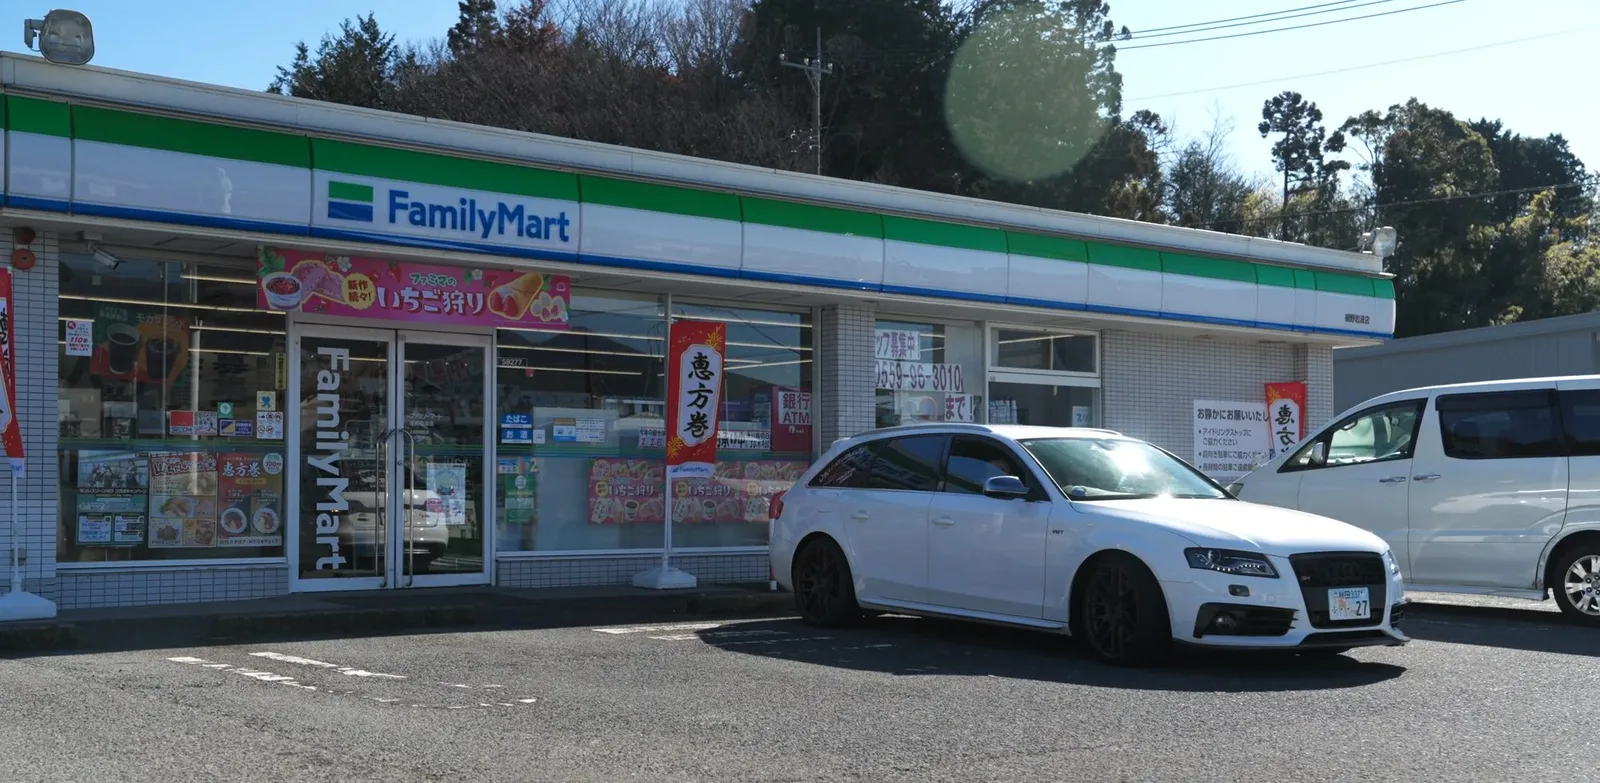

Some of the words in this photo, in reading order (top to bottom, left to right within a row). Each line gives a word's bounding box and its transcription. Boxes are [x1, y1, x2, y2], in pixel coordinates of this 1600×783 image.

[388, 189, 570, 242] FamilyMart
[348, 279, 368, 290] 新作
[410, 272, 457, 288] ファミマの
[376, 287, 484, 316] いちご狩り
[682, 351, 715, 438] 恵方巻
[783, 393, 810, 410] 銀行
[946, 396, 973, 421] まで!
[1197, 408, 1269, 422] お静かにお願いいたし
[506, 415, 528, 423] たばこ
[783, 411, 810, 424] ATM
[1203, 428, 1252, 437] アイドリングストップに
[308, 346, 350, 570] FamilyMart
[222, 461, 261, 477] 恵方巻
[1355, 600, 1368, 616] 27
